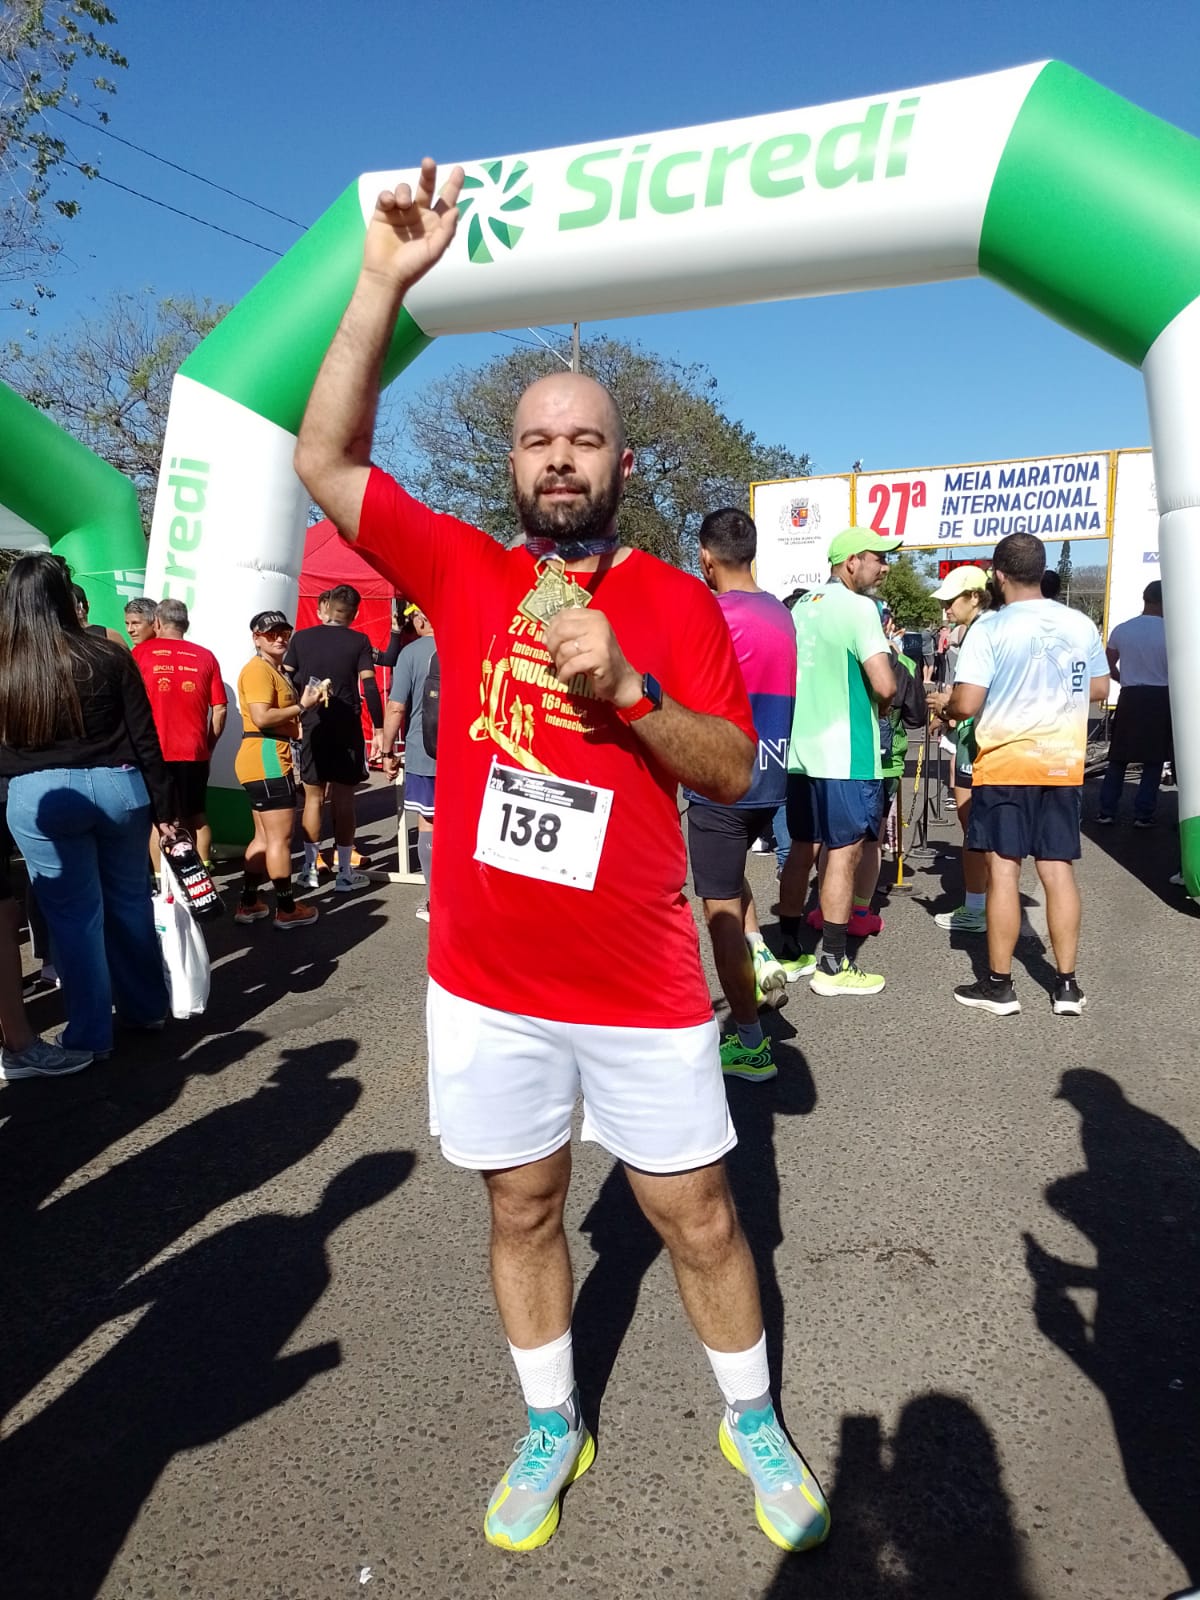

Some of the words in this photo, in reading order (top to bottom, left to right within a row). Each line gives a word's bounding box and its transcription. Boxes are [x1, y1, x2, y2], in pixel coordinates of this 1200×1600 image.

[558, 97, 921, 231] Sicredi
[944, 470, 992, 492] MEIA
[998, 461, 1100, 489] MARATONA
[941, 486, 1098, 516] INTERNACIONAL
[163, 457, 210, 612] credi
[938, 520, 963, 539] DE
[973, 511, 1101, 537] URUGUAIANA
[512, 641, 554, 663] Internac
[500, 803, 562, 852] 138
[182, 869, 207, 887] WATS
[187, 879, 212, 897] WATS
[192, 890, 217, 908] WATS
